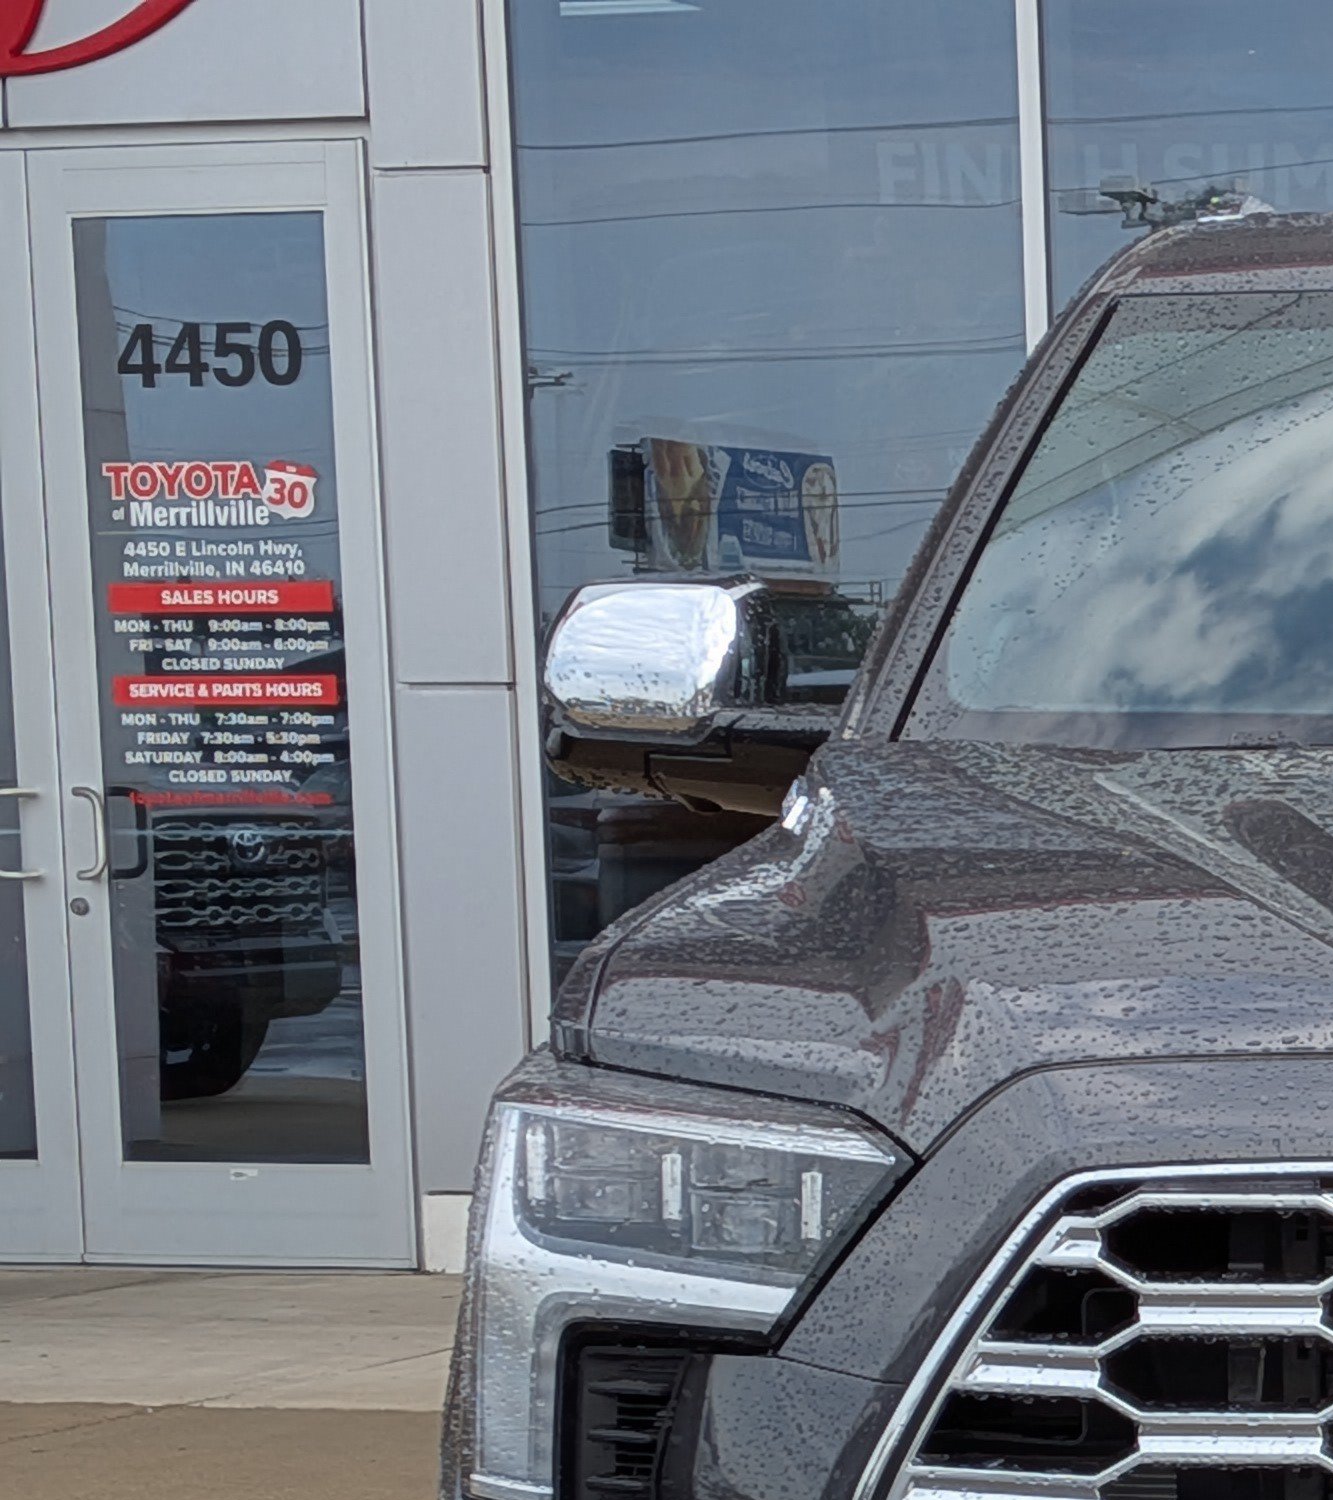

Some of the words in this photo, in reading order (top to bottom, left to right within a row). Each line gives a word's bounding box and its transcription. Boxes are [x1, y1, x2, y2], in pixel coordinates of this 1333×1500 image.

[118, 320, 302, 388] 4450
[102, 461, 262, 500] TOYOTA
[267, 478, 309, 509] 30
[112, 507, 125, 521] of
[130, 500, 270, 527] Merrillville
[123, 541, 170, 557] 4450
[175, 541, 186, 557] E
[191, 540, 254, 556] Lincoln
[259, 540, 302, 558] Hwy,
[123, 561, 220, 578] Merrillville,
[226, 560, 245, 576] IN
[250, 560, 305, 576] 46410
[161, 590, 214, 605] SALES
[218, 590, 279, 605] HOURS
[114, 620, 151, 632] MON
[162, 620, 194, 632] THU
[129, 639, 153, 651] FRI
[165, 639, 192, 651] SAT
[162, 658, 220, 671] CLOSED
[223, 658, 285, 670] SUNDAY
[129, 683, 195, 698] SERVICE
[198, 684, 209, 697] &
[212, 683, 262, 697] PARTS
[266, 683, 323, 697] HOURS
[121, 713, 157, 726] MON
[168, 713, 200, 725] THU
[137, 732, 190, 745] FRIDAY
[125, 751, 203, 764] SATURDAY
[169, 770, 227, 783] CLOSED
[230, 770, 293, 783] SUNDAY
